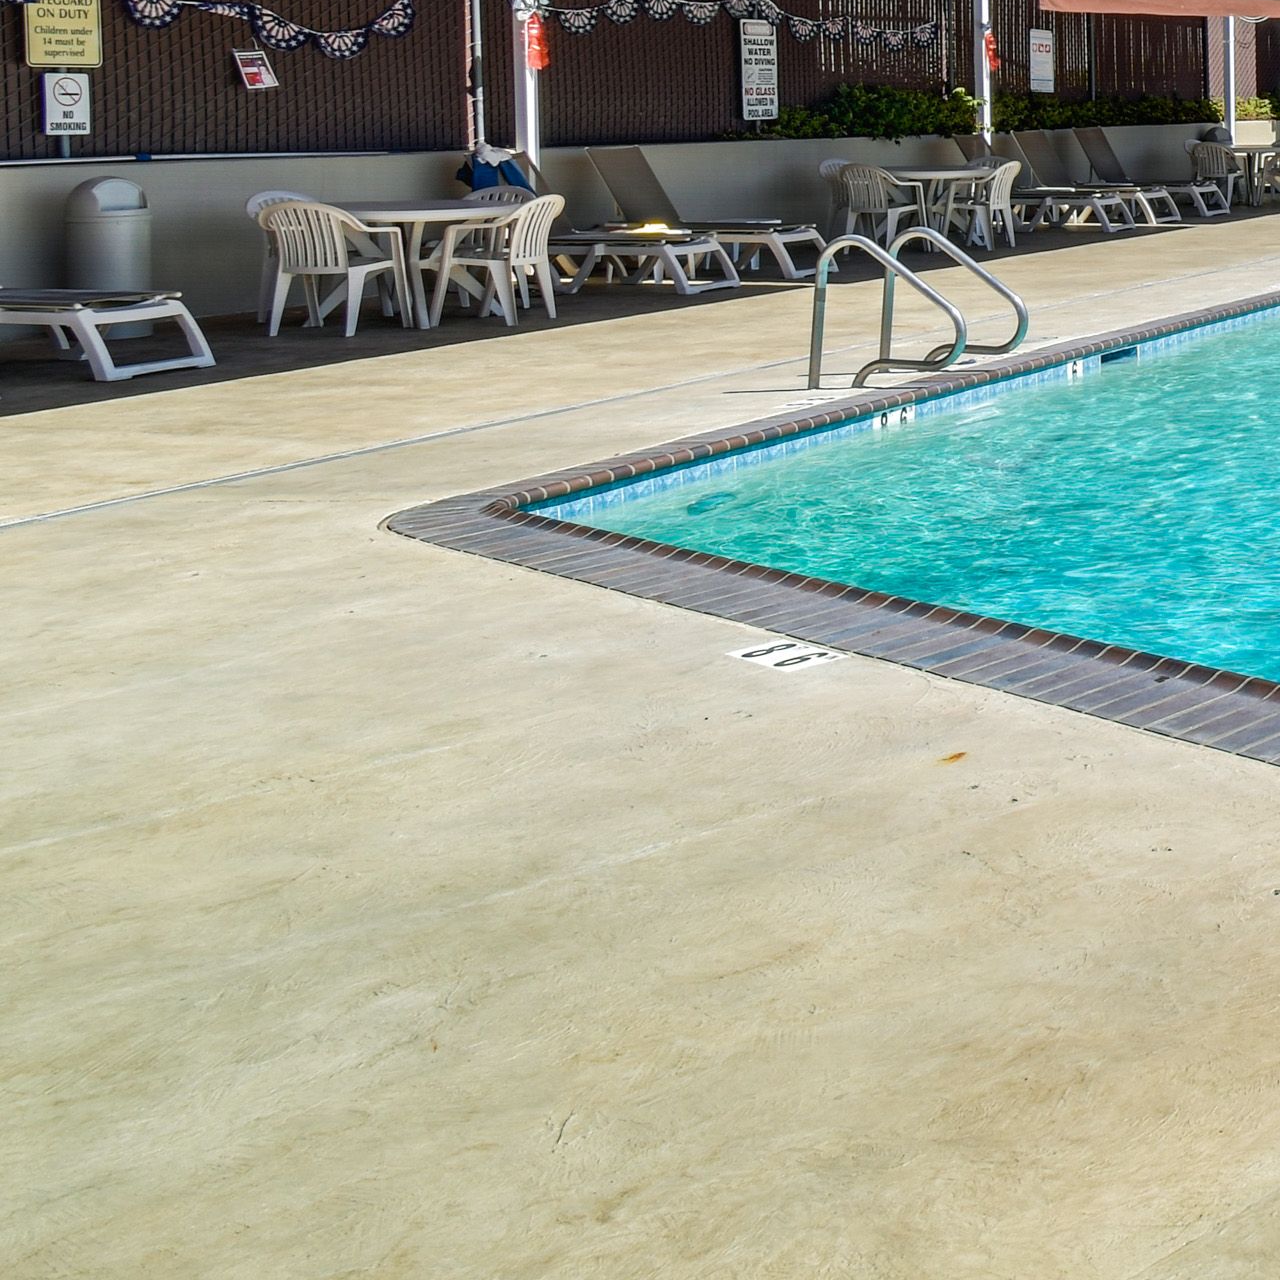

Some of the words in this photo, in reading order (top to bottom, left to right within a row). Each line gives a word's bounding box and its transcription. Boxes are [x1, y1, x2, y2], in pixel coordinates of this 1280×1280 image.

[36, 7, 55, 18] ON
[59, 8, 90, 19] DUTY
[34, 25, 68, 35] Children
[70, 27, 93, 35] under
[43, 37, 52, 45] 14
[55, 37, 74, 46] must
[76, 37, 86, 46] be
[743, 38, 775, 47] SHALLOW
[44, 48, 85, 58] supervised
[747, 47, 771, 56] WATER
[743, 57, 753, 66] NO
[754, 57, 776, 66] DIVING
[744, 86, 754, 96] NO
[755, 86, 776, 96] GLASS
[747, 97, 768, 107] ALLOWED
[62, 110, 74, 119] NO
[748, 108, 761, 118] POOL
[50, 122, 87, 131] SMOKING
